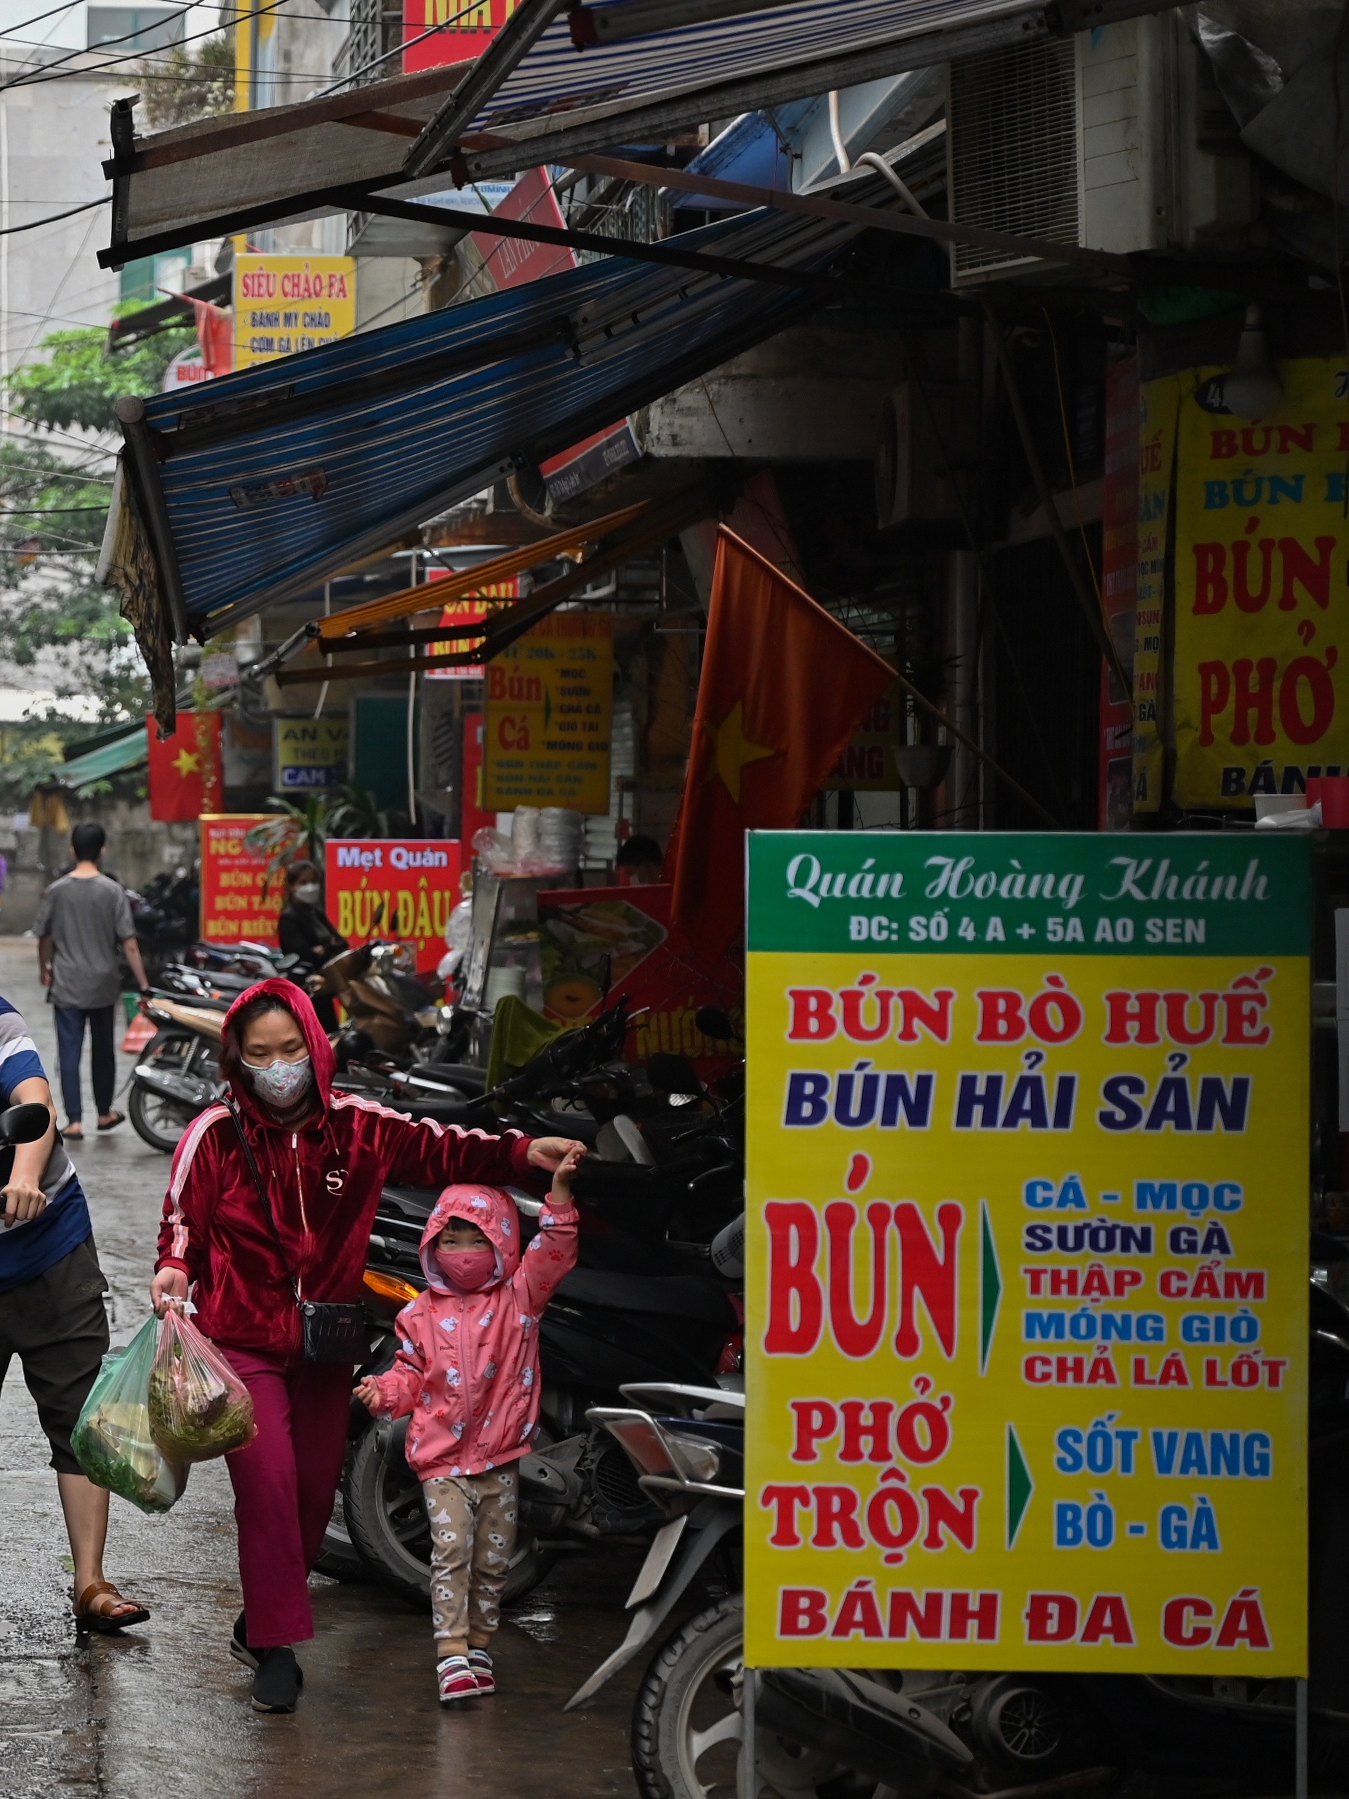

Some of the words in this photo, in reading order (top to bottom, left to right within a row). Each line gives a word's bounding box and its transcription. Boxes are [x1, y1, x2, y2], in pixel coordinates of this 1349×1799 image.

[242, 264, 277, 298] SIÊU
[281, 262, 324, 298] CHẢO
[251, 308, 280, 328] BÁNH
[1210, 418, 1317, 459] BÚN
[1203, 468, 1307, 510] BÚN
[1192, 515, 1338, 616] BÚN
[489, 665, 542, 701] Bún
[1198, 619, 1339, 747] PHỞ
[497, 715, 531, 751] Cá
[337, 846, 383, 873] Mẹt
[389, 846, 448, 871] Quán
[785, 854, 907, 909] Quán
[923, 856, 1087, 910] Hoàng
[1099, 857, 1271, 901] Khánh
[338, 874, 391, 939] BÚN
[394, 873, 452, 951] ĐẬU
[849, 914, 899, 942] ĐC:
[909, 907, 950, 941] SỐ
[1046, 917, 1084, 942] 5A
[1095, 918, 1135, 943] AO
[1145, 918, 1205, 944] SEN
[786, 972, 954, 1043] BÚN
[976, 973, 1082, 1044] BÒ
[1103, 966, 1276, 1046] HUẾ
[782, 1061, 935, 1128] BÚN
[955, 1050, 1078, 1130] HẢI
[1097, 1052, 1251, 1131] SẢN
[1023, 1174, 1087, 1210] CÁ
[1135, 1181, 1243, 1215] MỌC
[763, 1153, 964, 1359] BÚN
[1023, 1217, 1153, 1255] SƯỜN
[1168, 1220, 1232, 1256] GÀ
[1023, 1264, 1142, 1303] THẬP
[1159, 1259, 1266, 1300] CẨM
[1023, 1306, 1165, 1343] MÓNG
[1180, 1308, 1260, 1344] GIÒ
[1023, 1344, 1118, 1386] CHẢ
[1134, 1351, 1190, 1387] LÁ
[1204, 1350, 1288, 1388] LỐT
[790, 1375, 952, 1464] PHỞ
[1056, 1412, 1139, 1475] SỐT
[1153, 1429, 1272, 1477] VANG
[761, 1466, 979, 1566] TRỘN
[1056, 1492, 1115, 1548] BÒ
[1159, 1495, 1219, 1551] GÀ
[778, 1577, 1000, 1641] BÁNH
[1025, 1592, 1134, 1645] ĐA
[1163, 1586, 1271, 1649] CÁ
